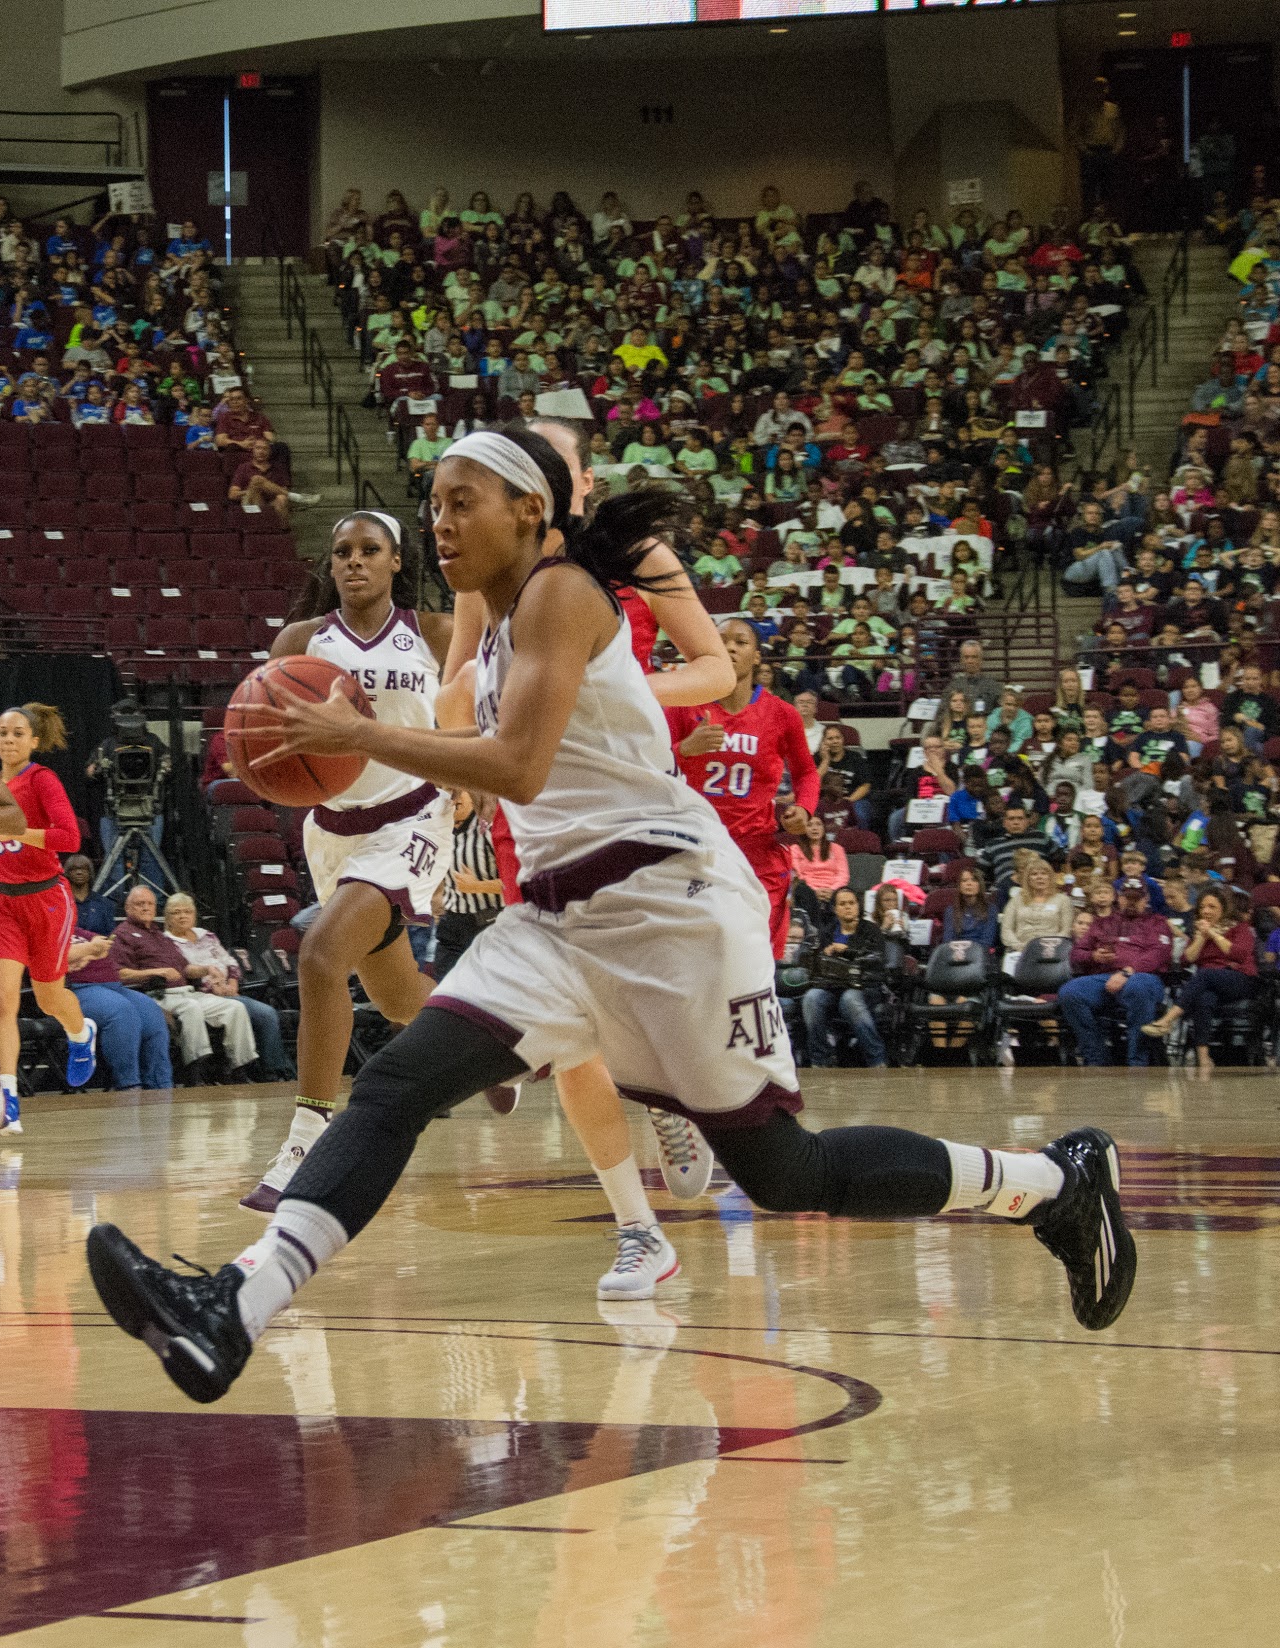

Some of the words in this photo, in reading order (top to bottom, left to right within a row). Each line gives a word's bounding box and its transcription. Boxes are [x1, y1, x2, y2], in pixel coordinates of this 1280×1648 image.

[641, 105, 673, 124] 111
[385, 669, 424, 693] A&M
[720, 732, 758, 755] MU
[703, 761, 753, 798] 20
